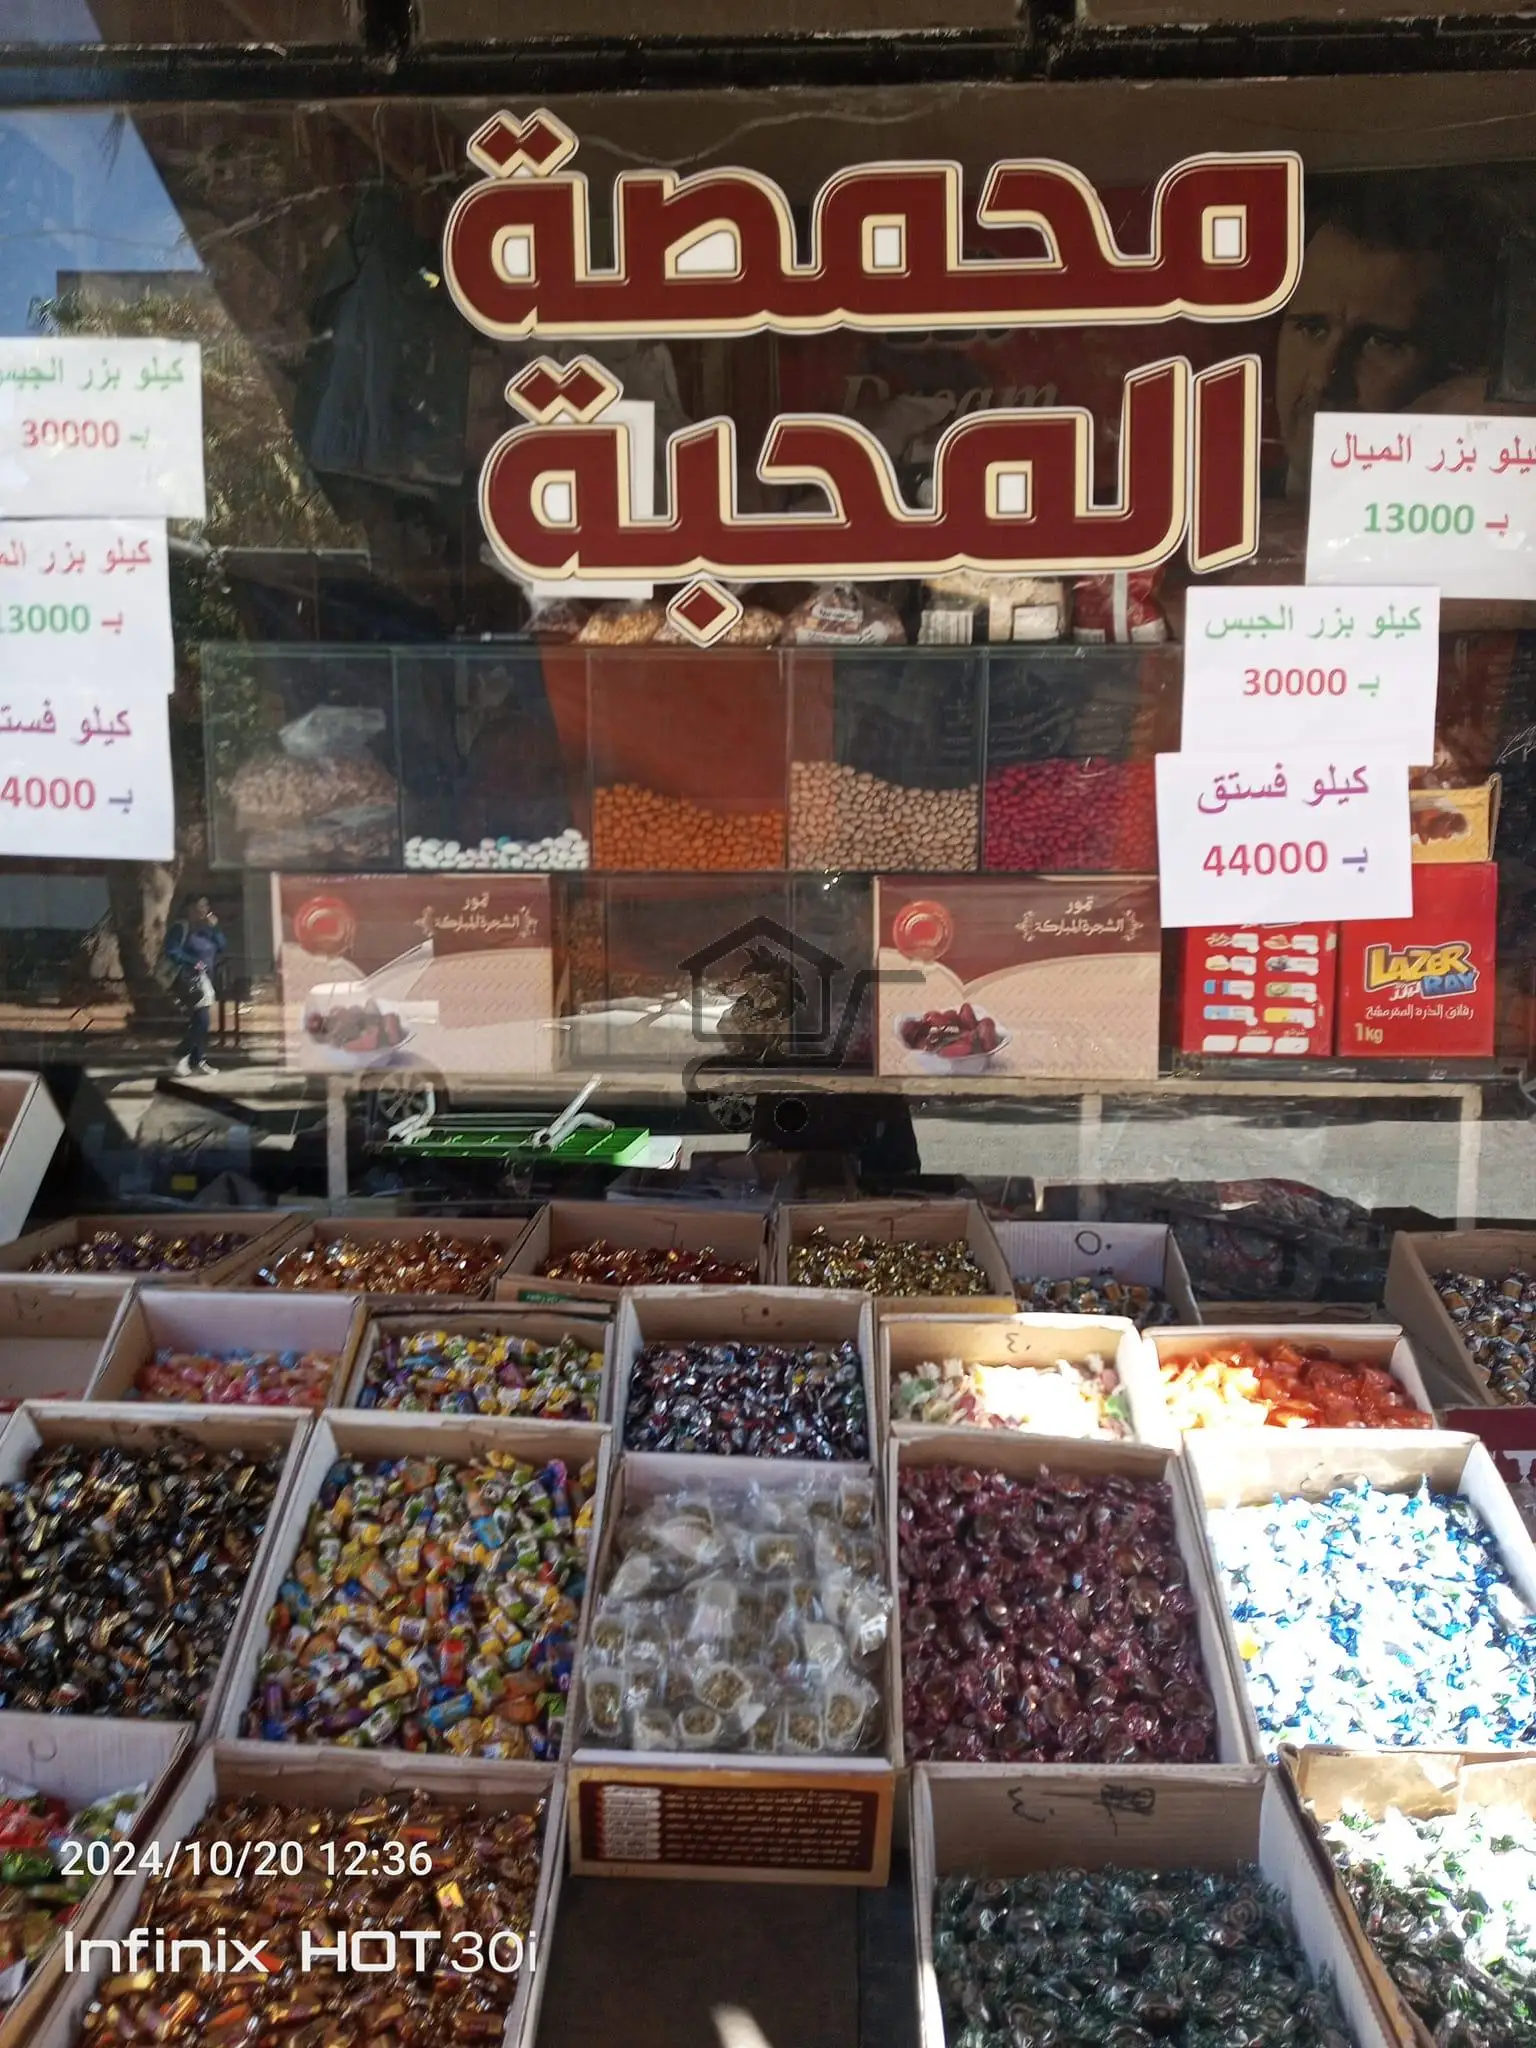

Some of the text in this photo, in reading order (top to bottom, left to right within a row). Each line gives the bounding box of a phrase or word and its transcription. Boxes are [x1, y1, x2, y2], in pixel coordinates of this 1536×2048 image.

[446, 109, 1303, 338] محمصة
[78, 358, 121, 390] بزر
[134, 357, 184, 390] كيلو
[22, 419, 120, 448] 30000
[1330, 431, 1536, 474] يلو بزر الميال
[478, 355, 1262, 647] المحبة
[1364, 502, 1475, 535] 13000
[41, 541, 86, 574] بزر
[101, 537, 152, 573] كيلو
[0, 604, 91, 634] 3000
[1205, 604, 1421, 640] كيلو بزر الجبس
[1243, 668, 1347, 696] 30000
[72, 705, 132, 746] كيلو
[1197, 762, 1369, 814] كيلو فستق
[1203, 840, 1328, 877] 44000
[1064, 896, 1095, 915] تمور
[1082, 916, 1125, 936] الشجرة
[1368, 943, 1471, 989] LAZER
[1423, 971, 1476, 994] RAY
